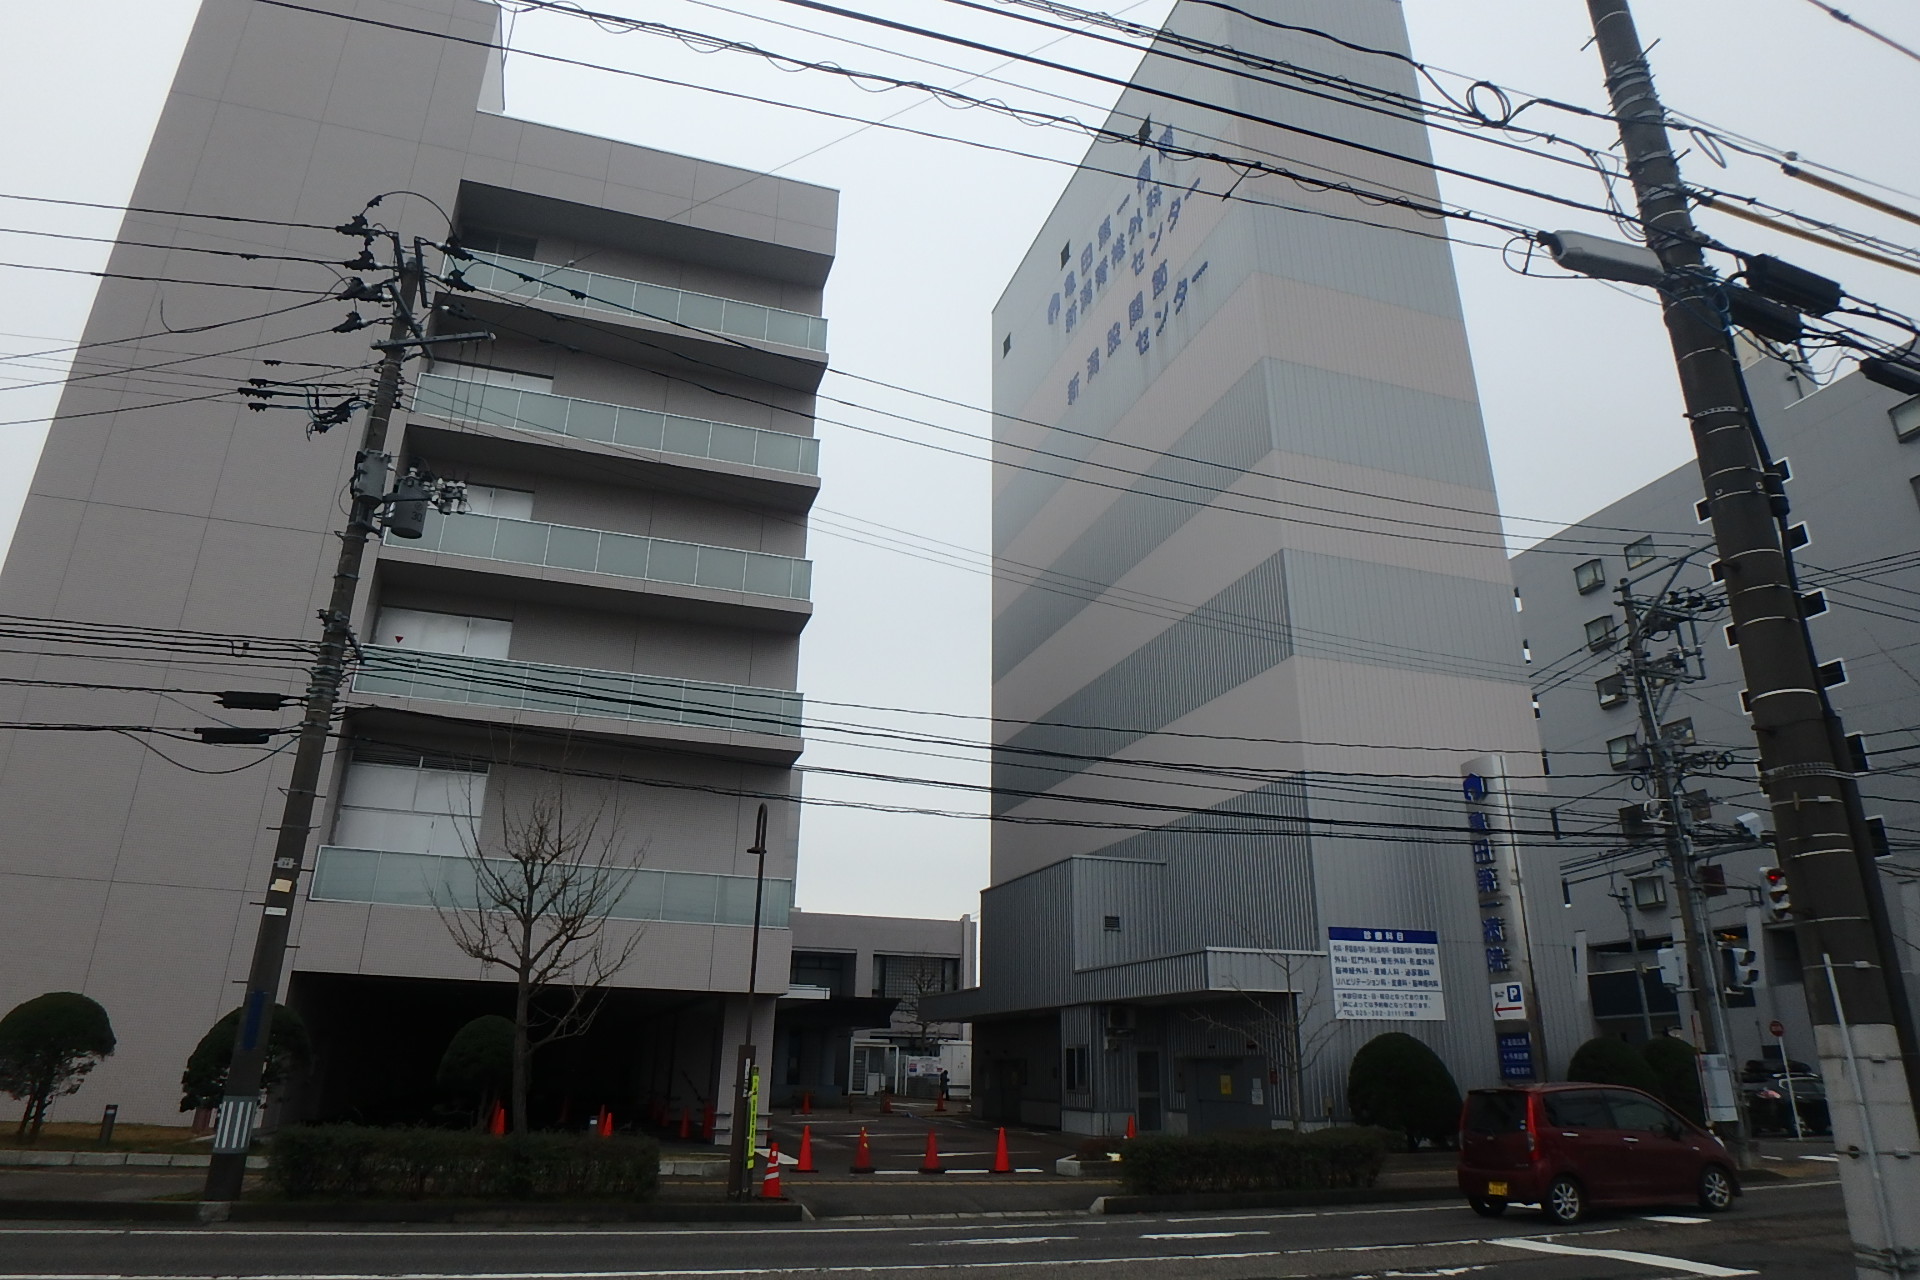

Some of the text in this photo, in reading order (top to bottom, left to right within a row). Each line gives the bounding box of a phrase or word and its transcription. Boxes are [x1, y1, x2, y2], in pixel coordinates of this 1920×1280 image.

[1136, 261, 1208, 356] センター
[1509, 987, 1518, 1000] P
